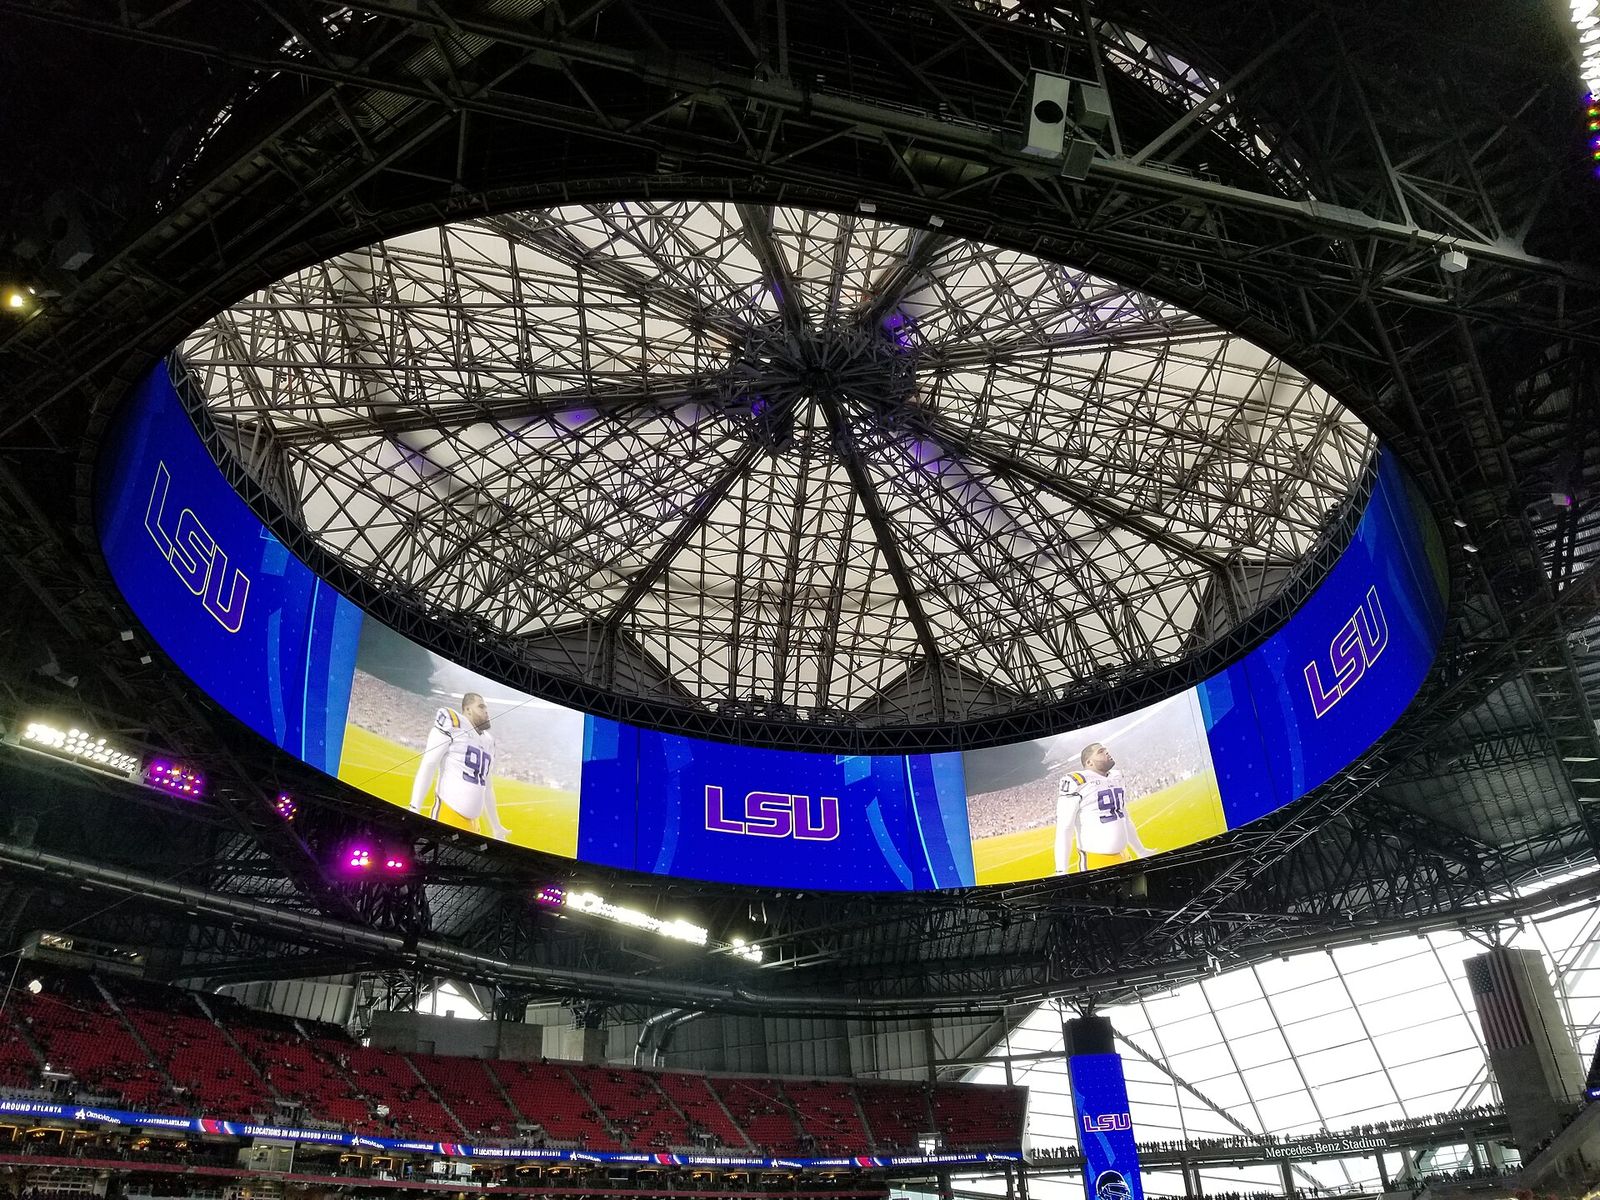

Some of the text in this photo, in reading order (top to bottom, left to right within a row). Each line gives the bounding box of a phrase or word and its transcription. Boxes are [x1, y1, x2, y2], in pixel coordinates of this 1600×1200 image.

[144, 459, 251, 633] LSU
[1304, 584, 1389, 719] LSU
[462, 745, 491, 786] 90
[705, 784, 840, 841] LSU
[1097, 787, 1125, 824] 90
[0, 1102, 62, 1114] AROUND ATLANTA
[244, 1126, 343, 1141] 13 LOCATIONS IN AND AROUND ATLANTA
[1083, 1113, 1131, 1132] LSU
[479, 1149, 503, 1157] LOCATIONS
[1265, 1137, 1387, 1159] Mercedes-Benz Stadium
[898, 1156, 922, 1164] LOCATIONS
